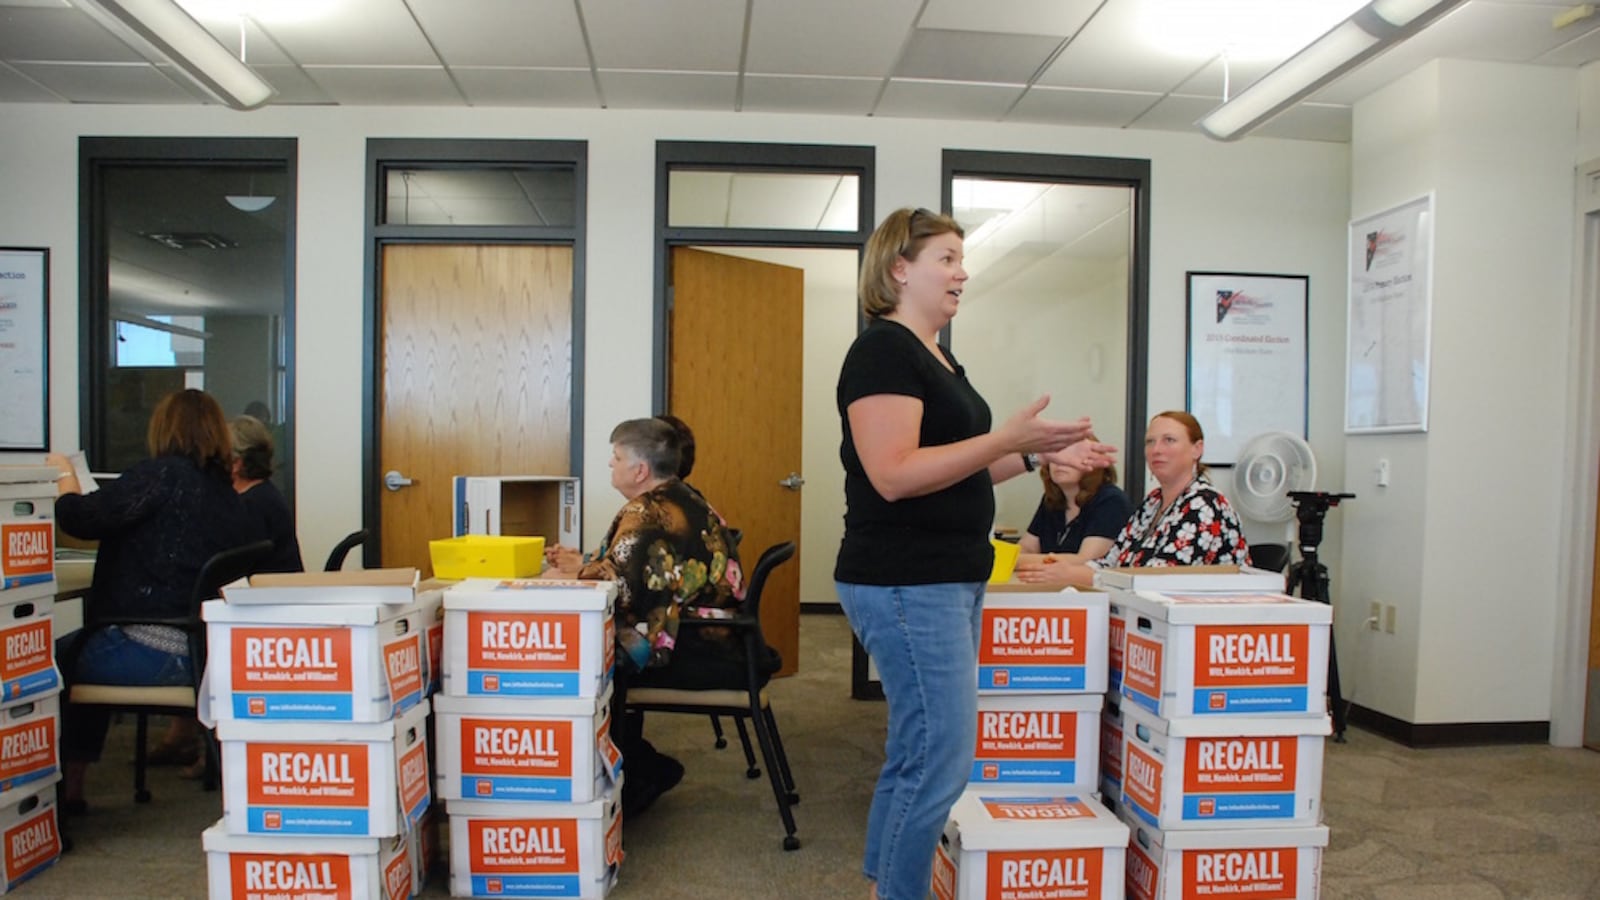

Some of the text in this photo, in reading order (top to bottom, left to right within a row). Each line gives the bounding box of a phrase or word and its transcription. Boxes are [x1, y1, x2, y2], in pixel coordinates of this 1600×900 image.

[8, 531, 49, 557] RECALL
[6, 628, 46, 661] RECALL
[482, 620, 567, 650] RECALL
[993, 616, 1074, 645] RECALL
[246, 637, 338, 668] RECALL
[388, 644, 418, 679] RECALL
[1127, 642, 1156, 676] RECALL
[1209, 633, 1295, 664] RECALL
[293, 672, 306, 680] and
[1252, 667, 1264, 675] and
[983, 713, 1064, 739] RECALL
[1, 726, 50, 761] RECALL
[474, 727, 559, 756] RECALL
[1024, 742, 1035, 750] and
[1198, 740, 1284, 771] RECALL
[262, 752, 354, 784] RECALL
[1128, 752, 1156, 793] RECALL
[1241, 774, 1253, 782] and
[309, 787, 322, 795] and
[1000, 807, 1082, 818] RECALL
[12, 820, 54, 860] RECALL
[482, 827, 565, 854] RECALL
[245, 860, 337, 890] RECALL
[1001, 857, 1089, 888] RECALL
[1196, 851, 1284, 883] RECALL
[1241, 884, 1253, 892] and
